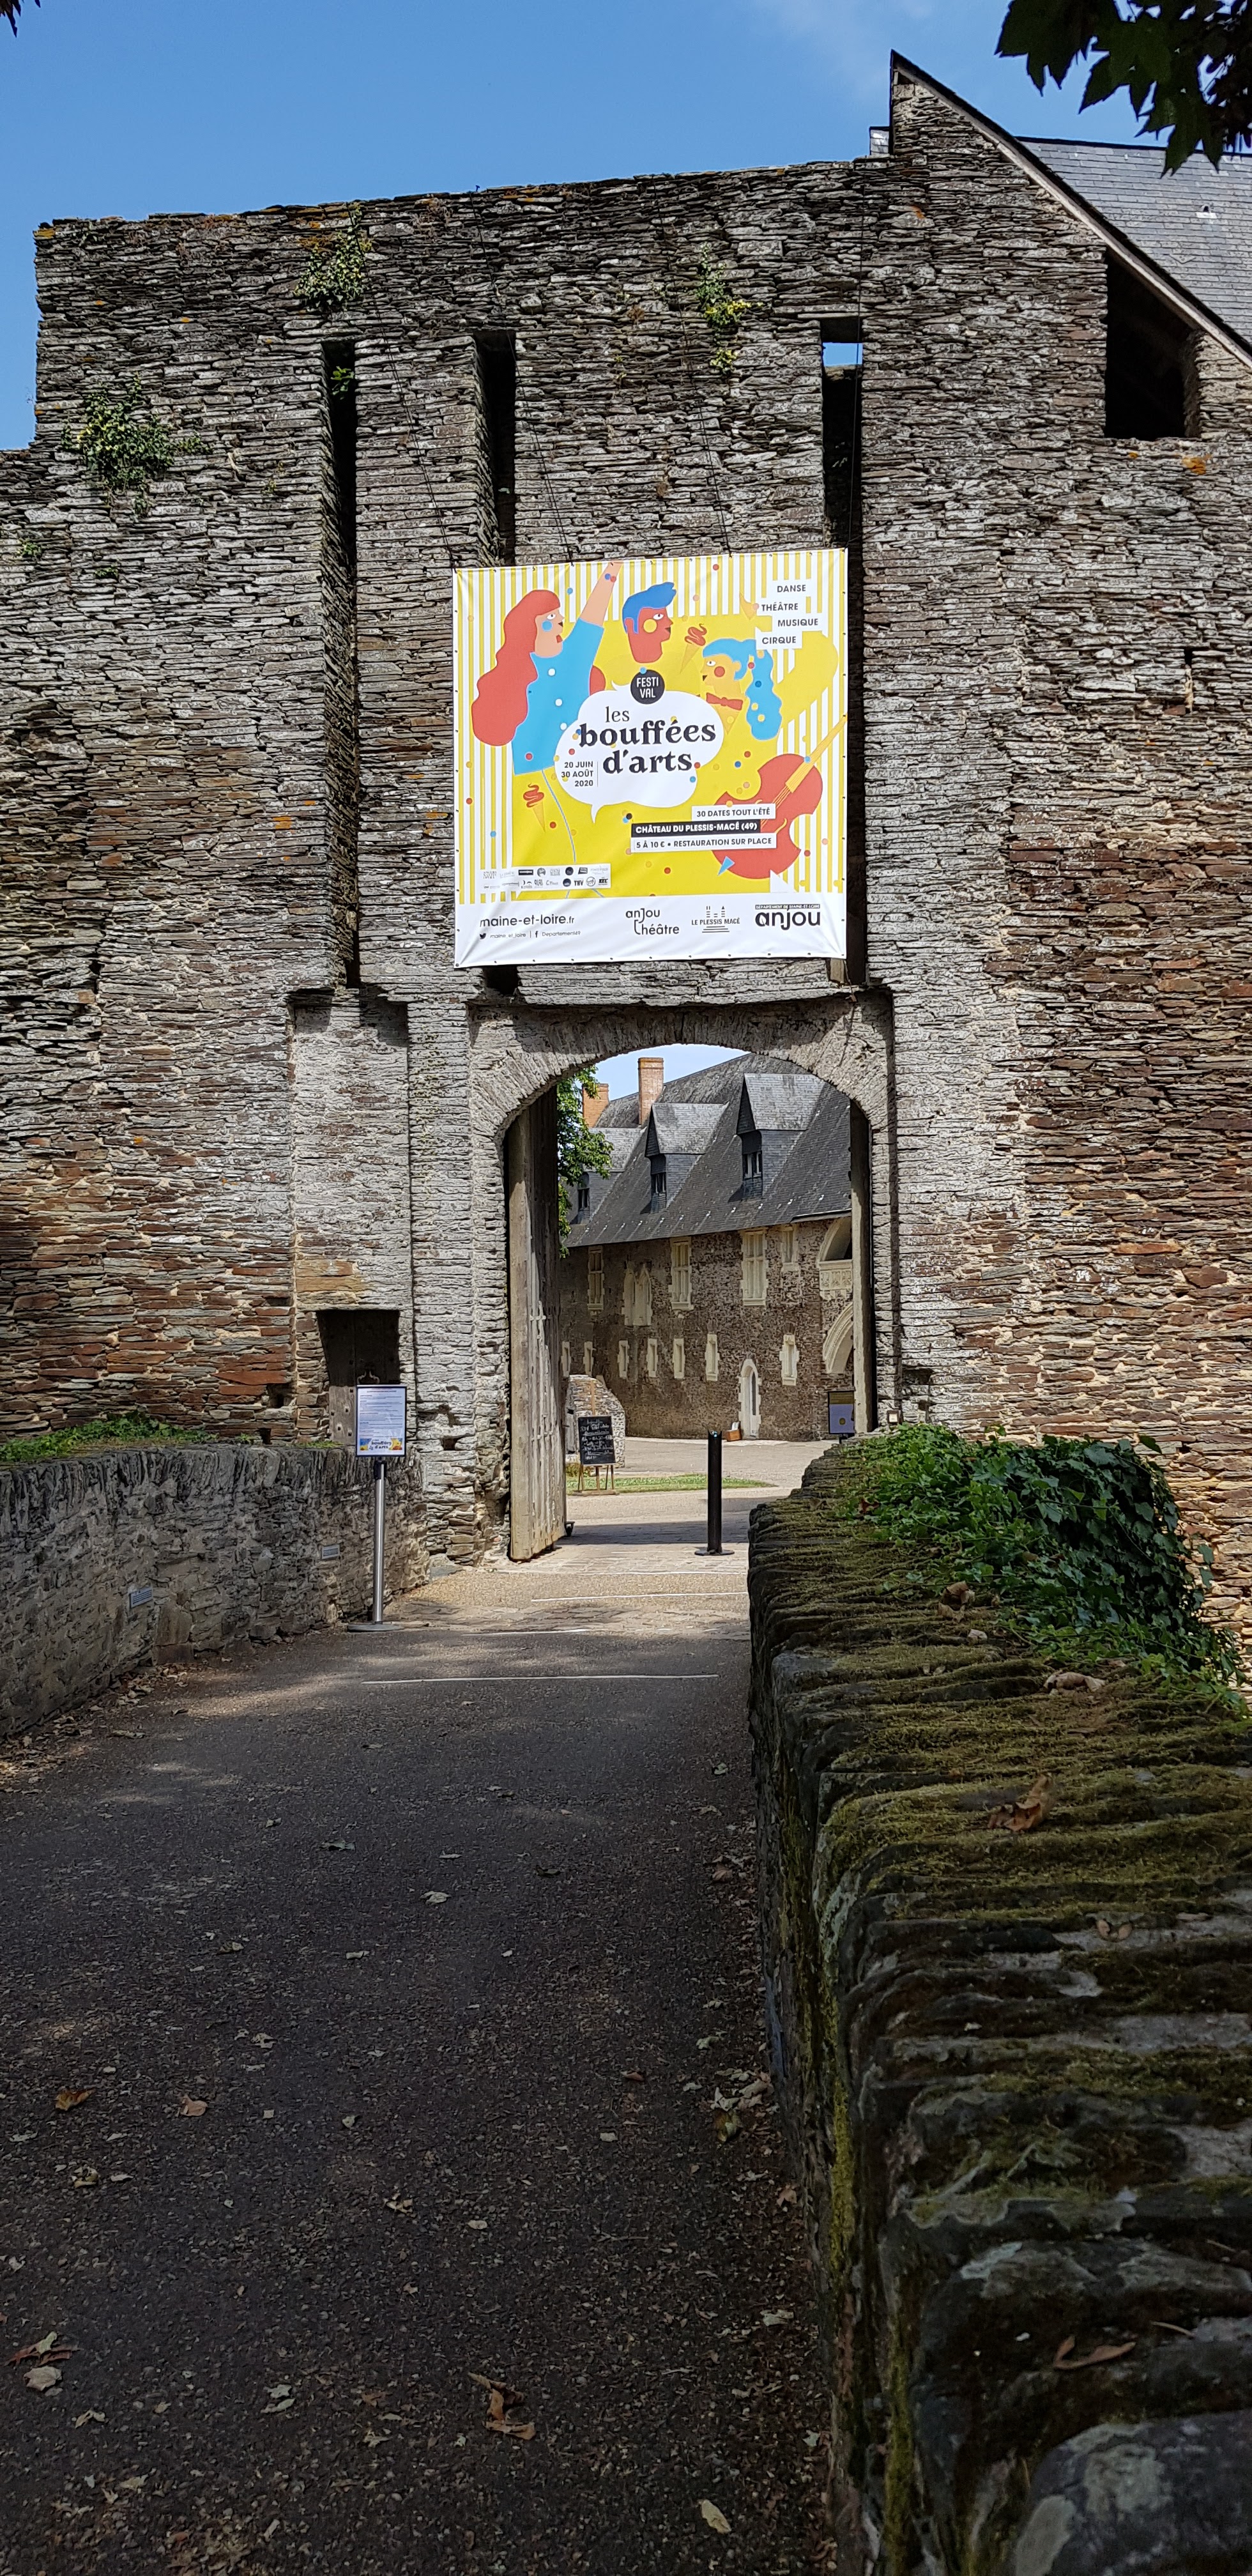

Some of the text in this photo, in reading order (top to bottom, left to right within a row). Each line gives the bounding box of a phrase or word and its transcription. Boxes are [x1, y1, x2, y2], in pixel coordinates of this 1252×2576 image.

[777, 585, 806, 593] DANSE
[761, 602, 798, 611] THÉÂTRE
[777, 618, 818, 627] MUSIQUE
[761, 636, 797, 645] CIRQUE
[636, 677, 659, 688] FESTI
[639, 688, 656, 698] VAL
[605, 706, 630, 723] les
[579, 719, 716, 747] bouffées
[603, 749, 692, 774] d'arts
[636, 824, 671, 834] CHÂTEAU
[685, 822, 740, 832] PLESSIS-MACÉ
[741, 822, 758, 831] (49)
[674, 838, 729, 847] RESTAURATION
[480, 914, 575, 927] maine-et-loire.fr
[755, 910, 820, 930] anjou
